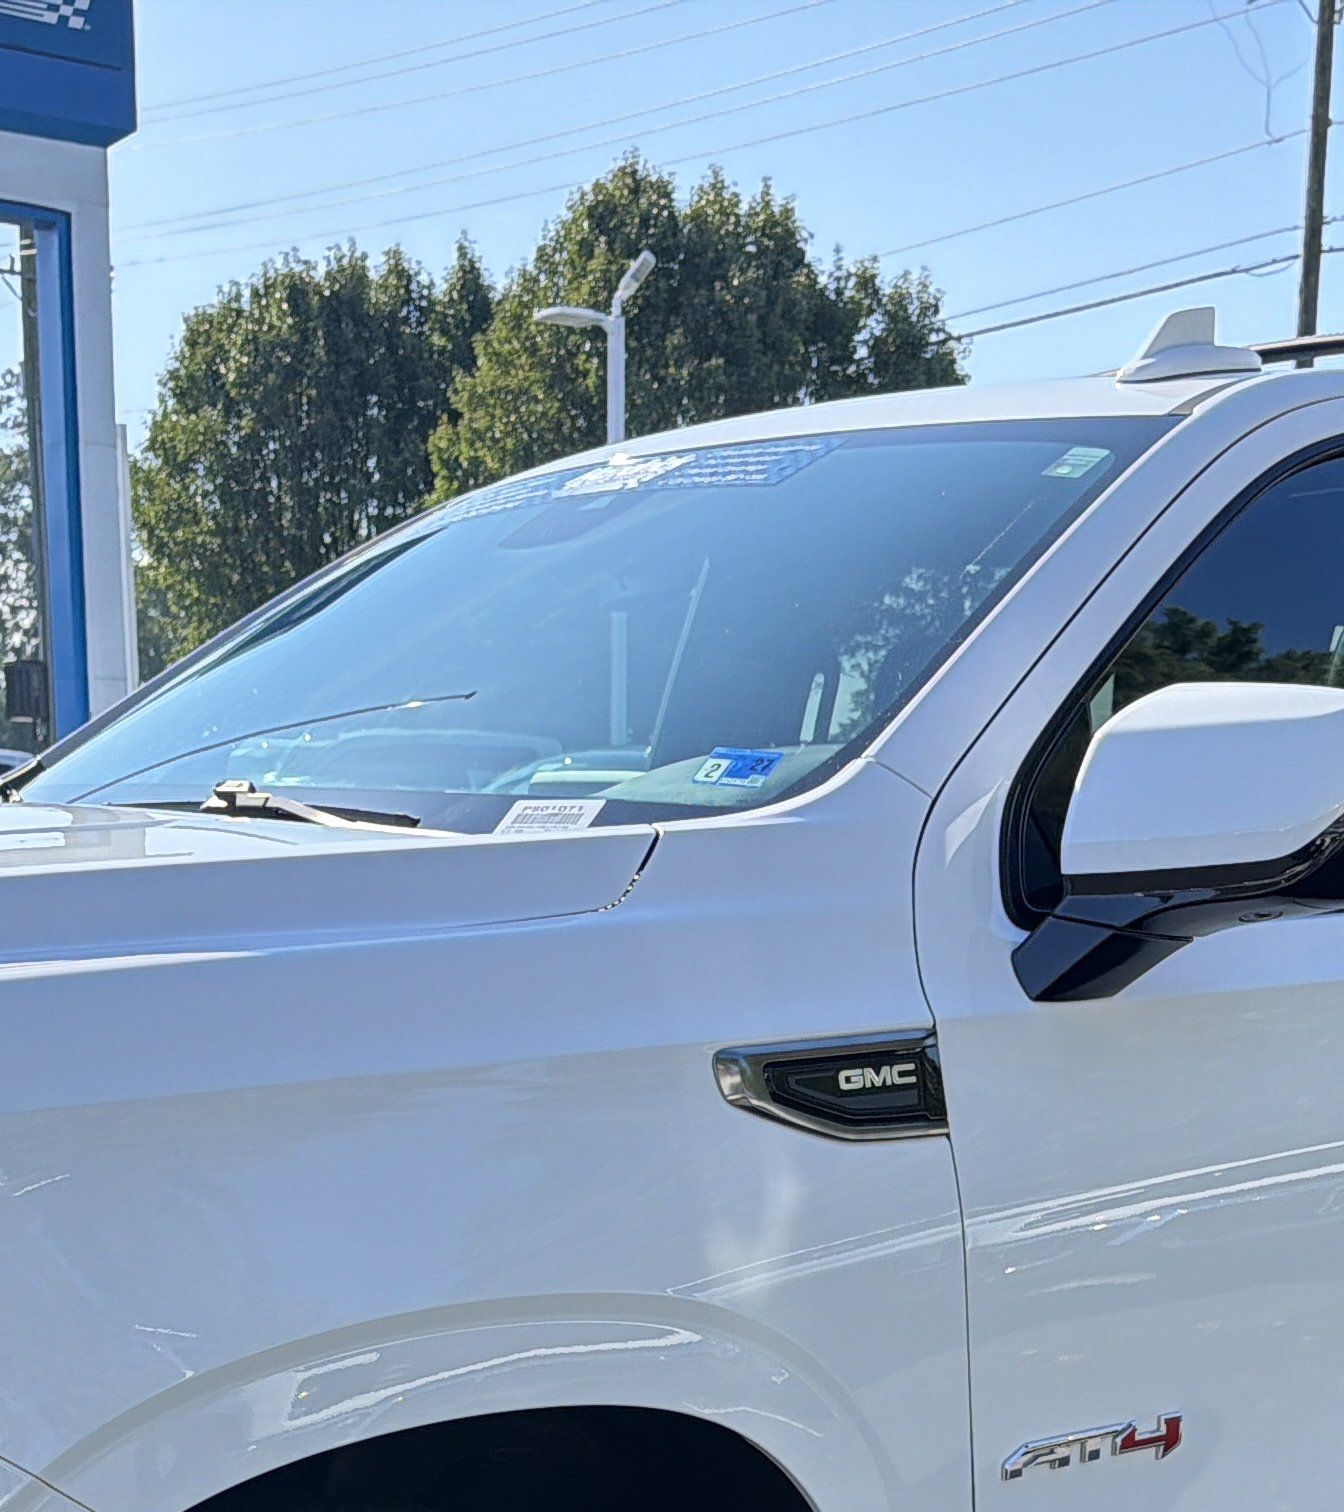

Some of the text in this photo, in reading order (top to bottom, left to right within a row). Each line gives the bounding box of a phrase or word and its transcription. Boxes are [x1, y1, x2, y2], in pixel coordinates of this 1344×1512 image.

[703, 763, 722, 779] 2
[838, 1062, 917, 1091] GMC
[1001, 1410, 1183, 1481] AT4
